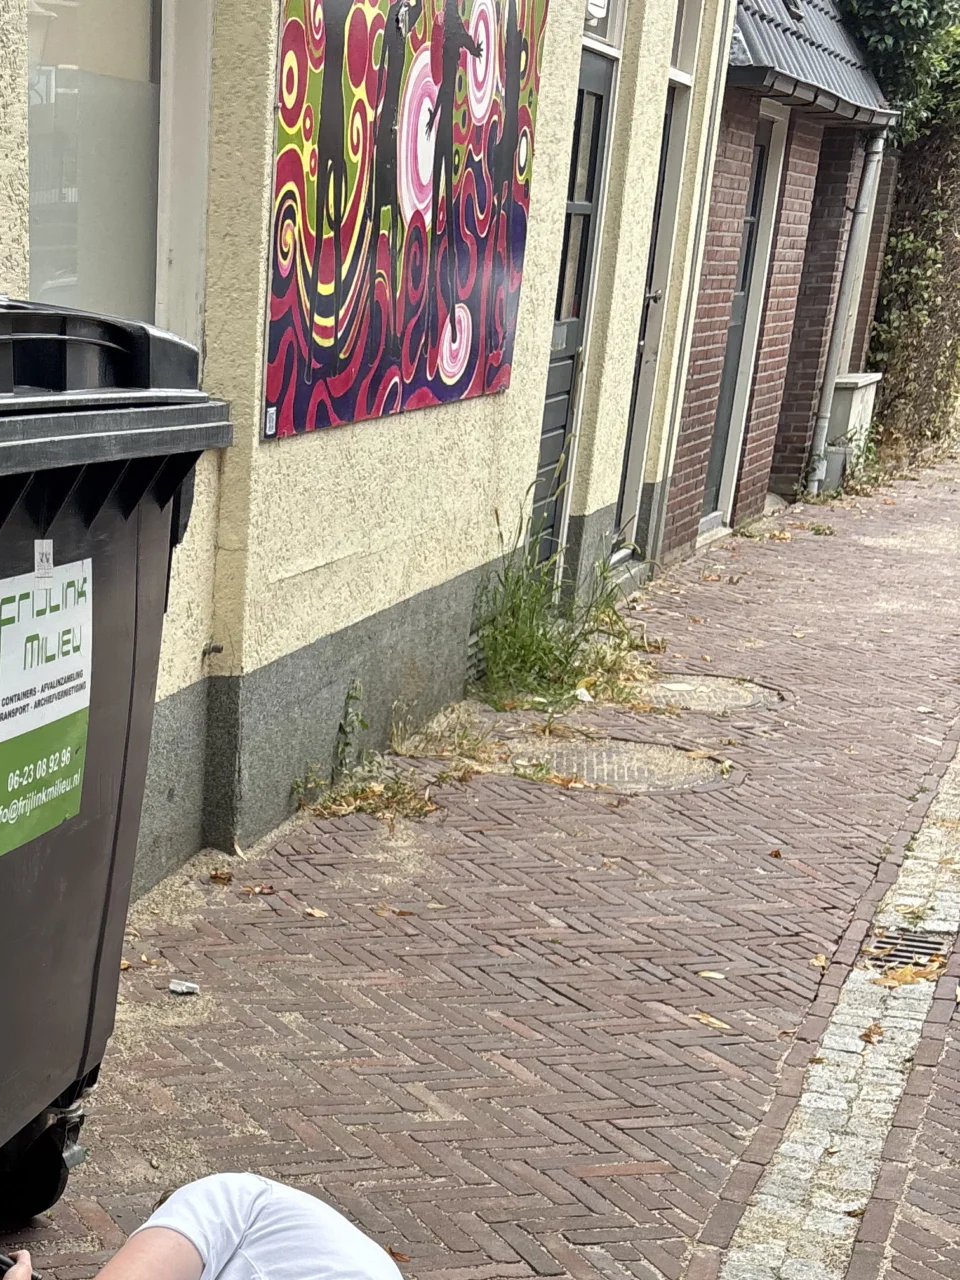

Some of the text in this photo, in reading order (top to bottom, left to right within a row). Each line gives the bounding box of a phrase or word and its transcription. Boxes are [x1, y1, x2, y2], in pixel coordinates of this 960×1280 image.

[1, 687, 37, 708] CONTAINERS
[40, 669, 83, 694] AFVALINZAMELING
[7, 746, 72, 792] 06-23 08 92 96
